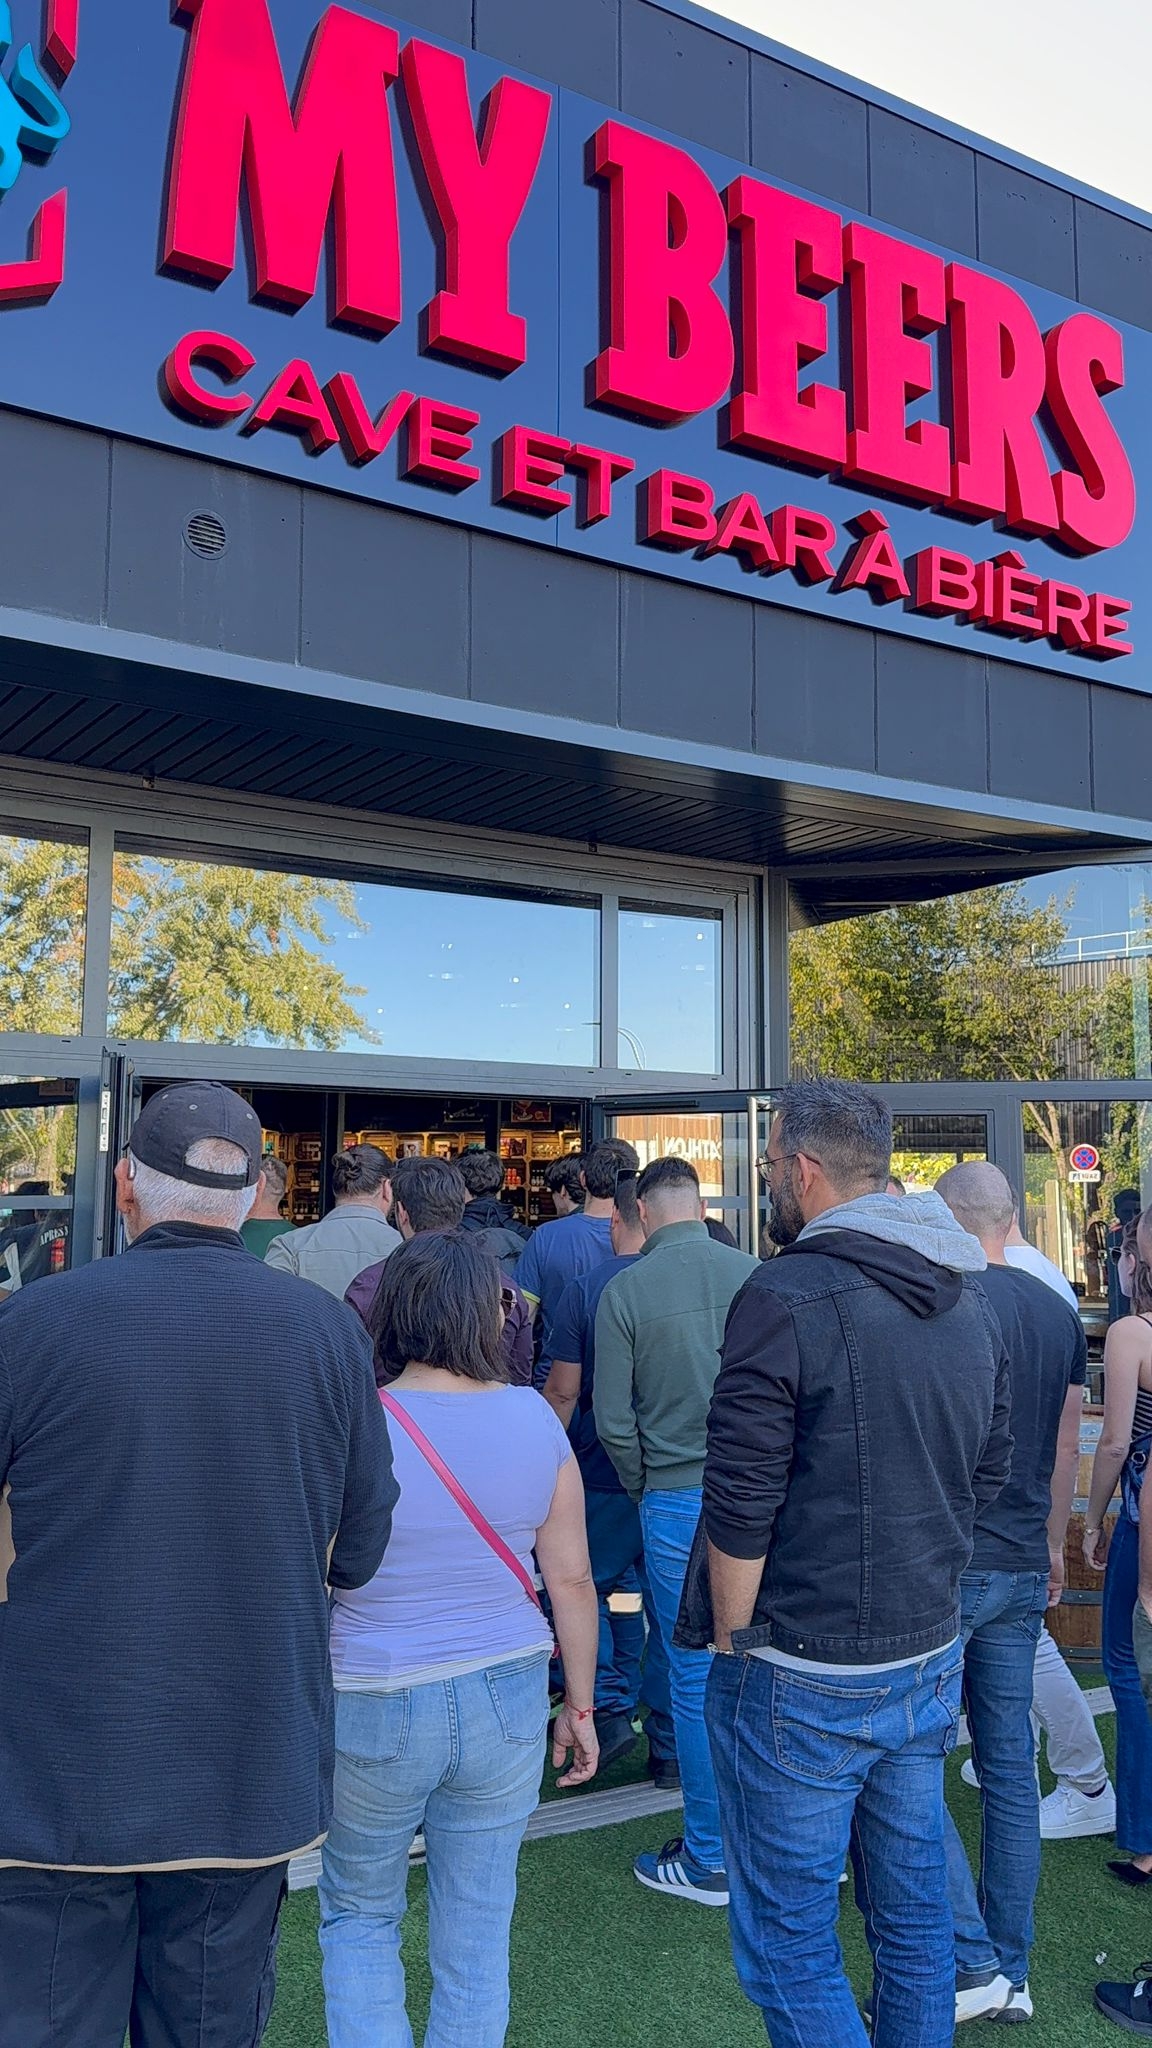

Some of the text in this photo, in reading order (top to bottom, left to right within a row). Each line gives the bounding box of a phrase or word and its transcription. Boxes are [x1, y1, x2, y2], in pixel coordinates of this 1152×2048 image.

[161, 330, 1134, 660] CAVE ET BAR À BIÈRE
[163, 0, 1136, 554] MY BEERS
